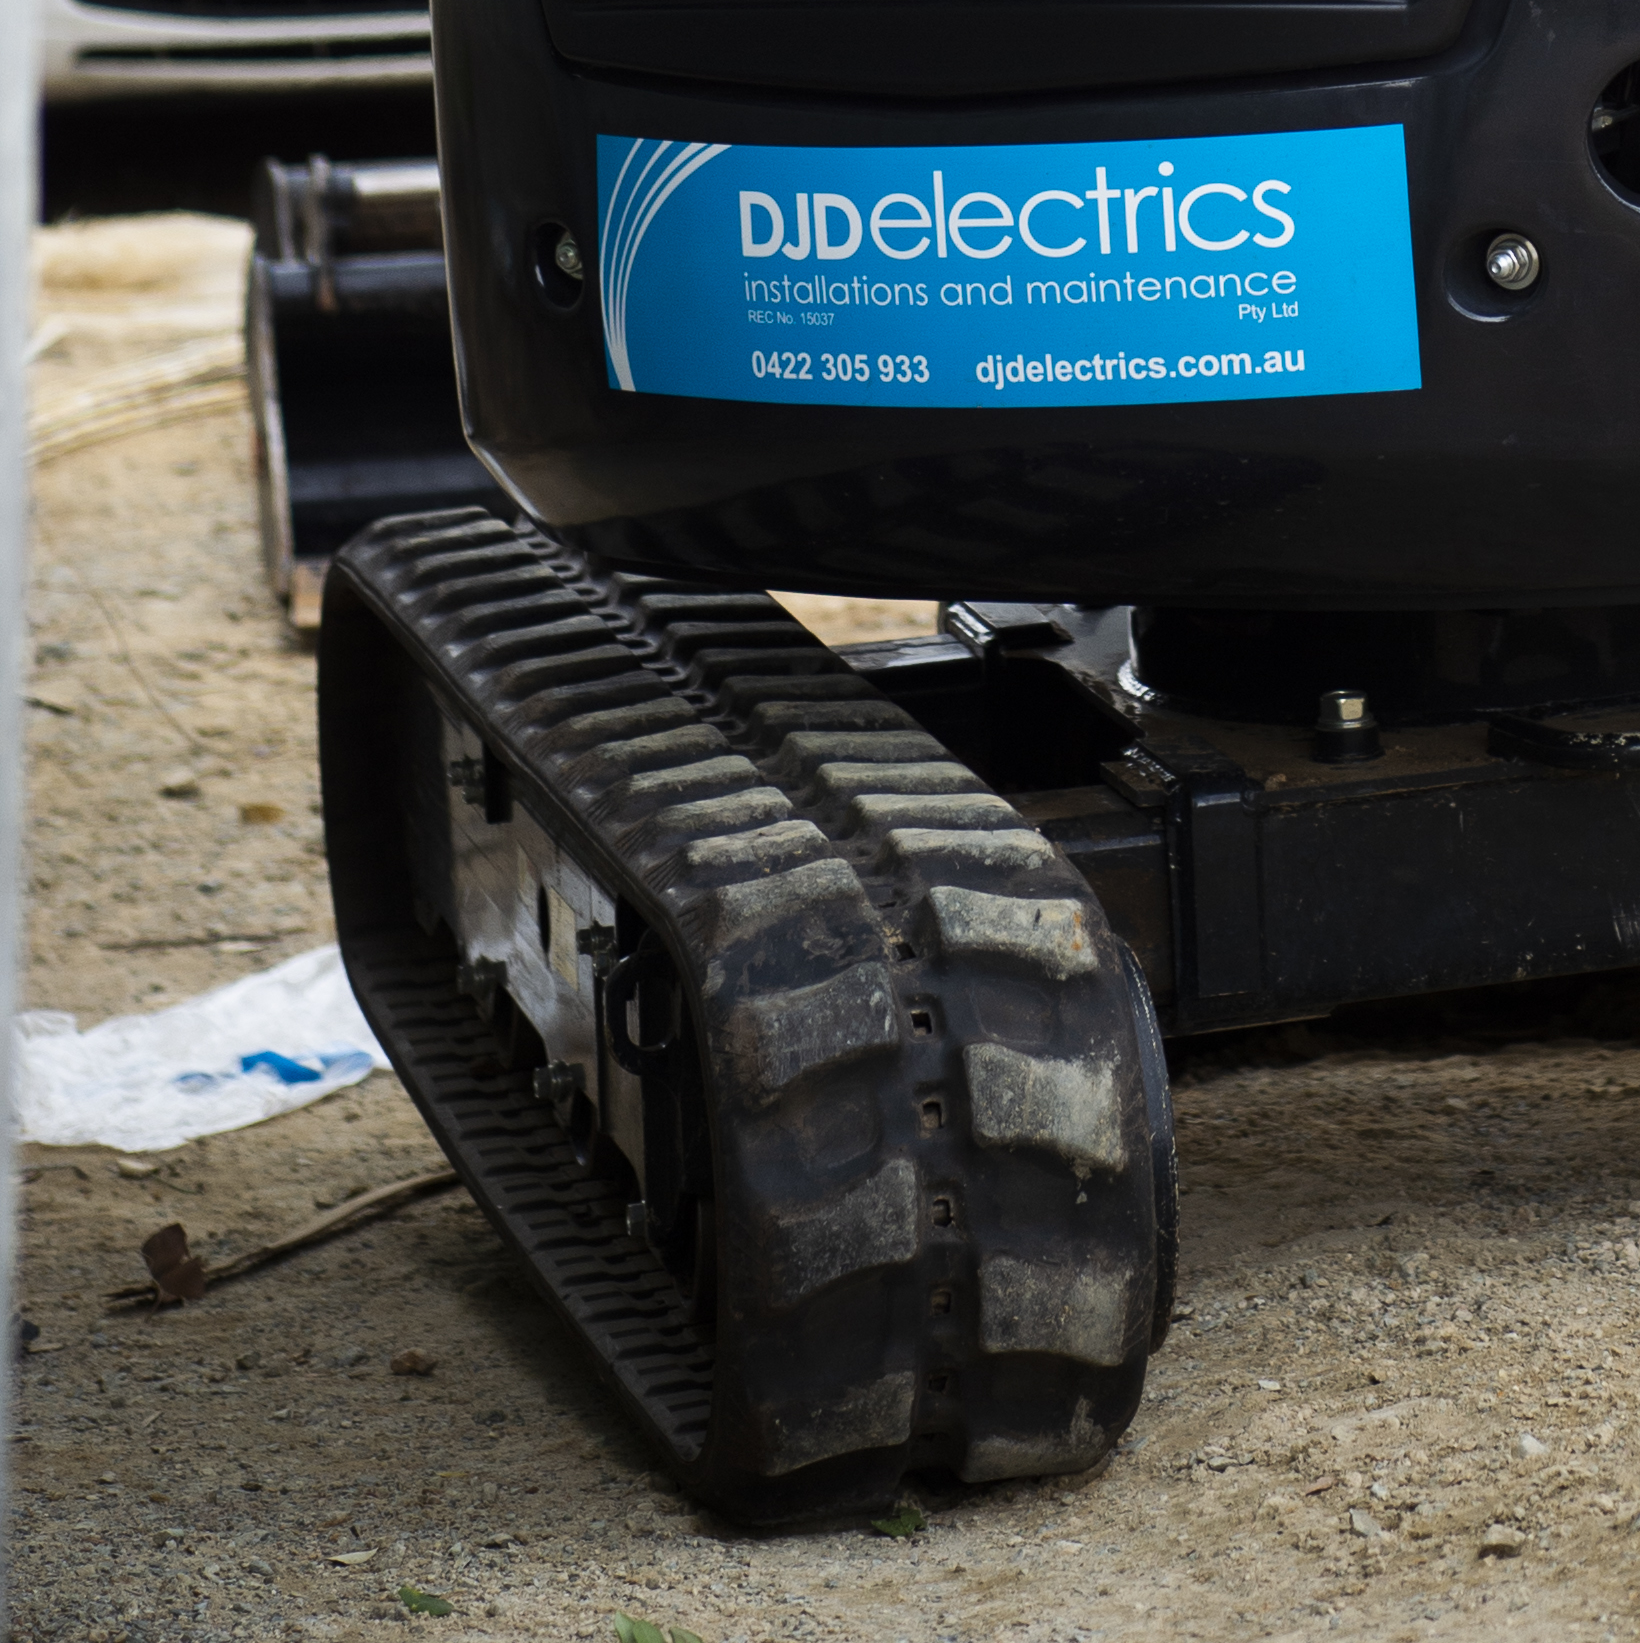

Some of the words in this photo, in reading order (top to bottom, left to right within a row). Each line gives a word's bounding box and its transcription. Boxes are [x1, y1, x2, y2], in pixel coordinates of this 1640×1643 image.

[743, 270, 929, 307] installations
[939, 272, 1012, 308] and
[1026, 267, 1297, 306] maintenance
[748, 310, 773, 325] REC
[800, 310, 835, 327] 15037
[1238, 302, 1268, 323] Pty
[1271, 301, 1299, 319] Ltd
[750, 350, 813, 381] 0422
[820, 353, 869, 383] 305
[877, 354, 930, 385] 933
[975, 347, 1306, 386] djdelectrics.com.au
